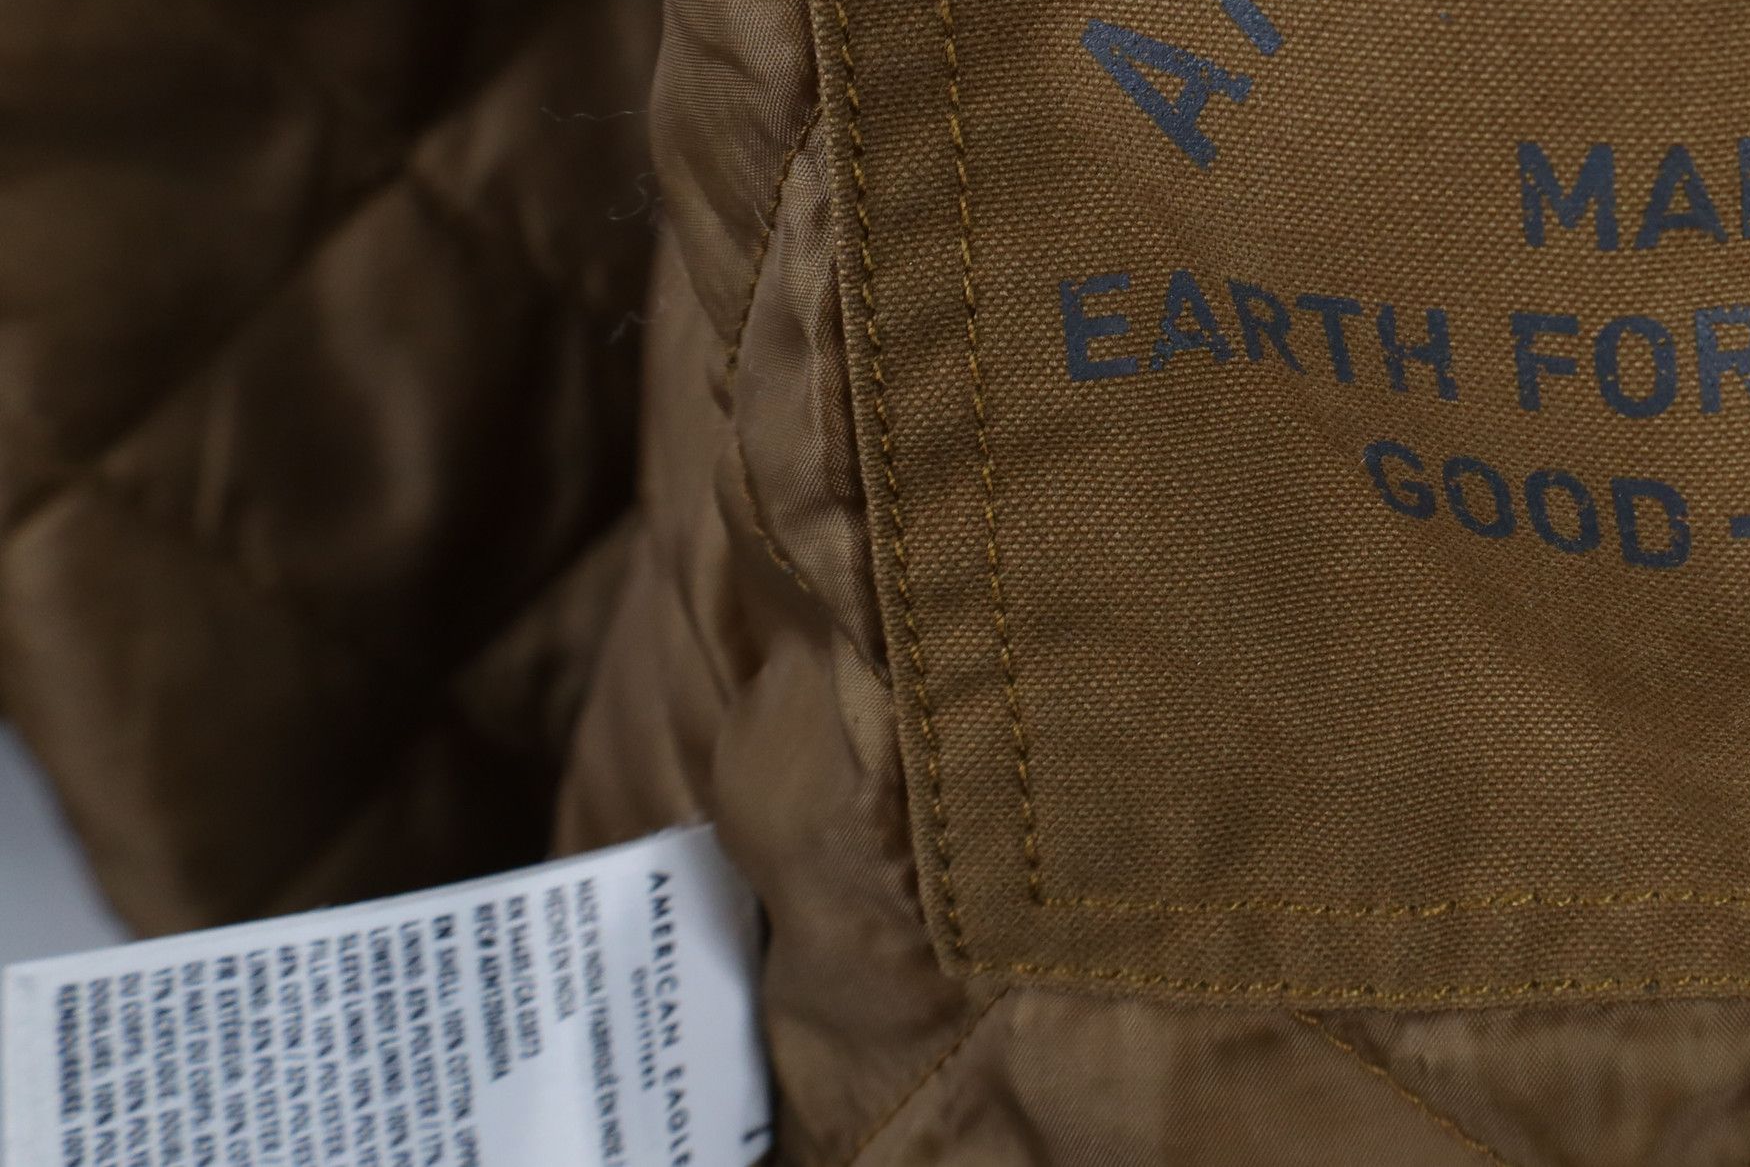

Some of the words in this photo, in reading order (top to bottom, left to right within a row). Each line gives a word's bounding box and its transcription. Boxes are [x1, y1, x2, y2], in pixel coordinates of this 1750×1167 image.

[1058, 268, 1458, 401] EARTH
[1362, 439, 1692, 570] GOOD
[648, 868, 680, 1048] AMERICAN
